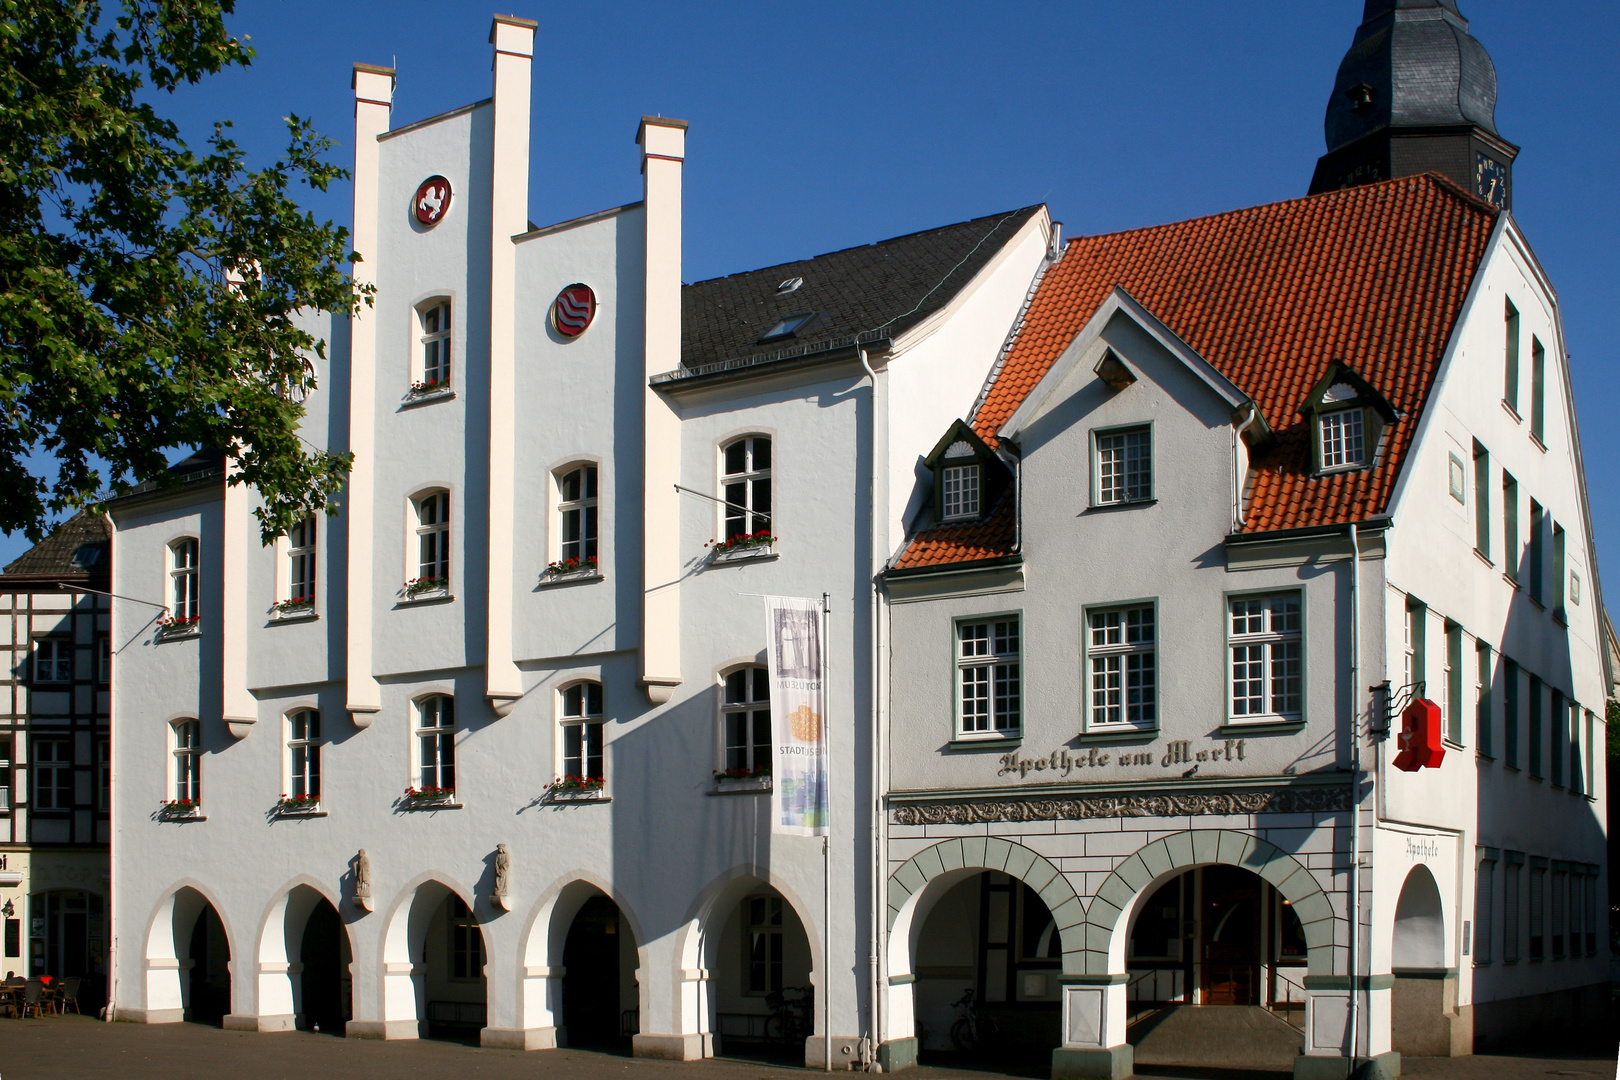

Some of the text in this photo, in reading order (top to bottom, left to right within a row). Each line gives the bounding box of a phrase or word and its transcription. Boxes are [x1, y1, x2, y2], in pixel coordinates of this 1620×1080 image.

[998, 738, 1246, 779] Apotheke am Markt
[1405, 836, 1438, 863] Apotheke
